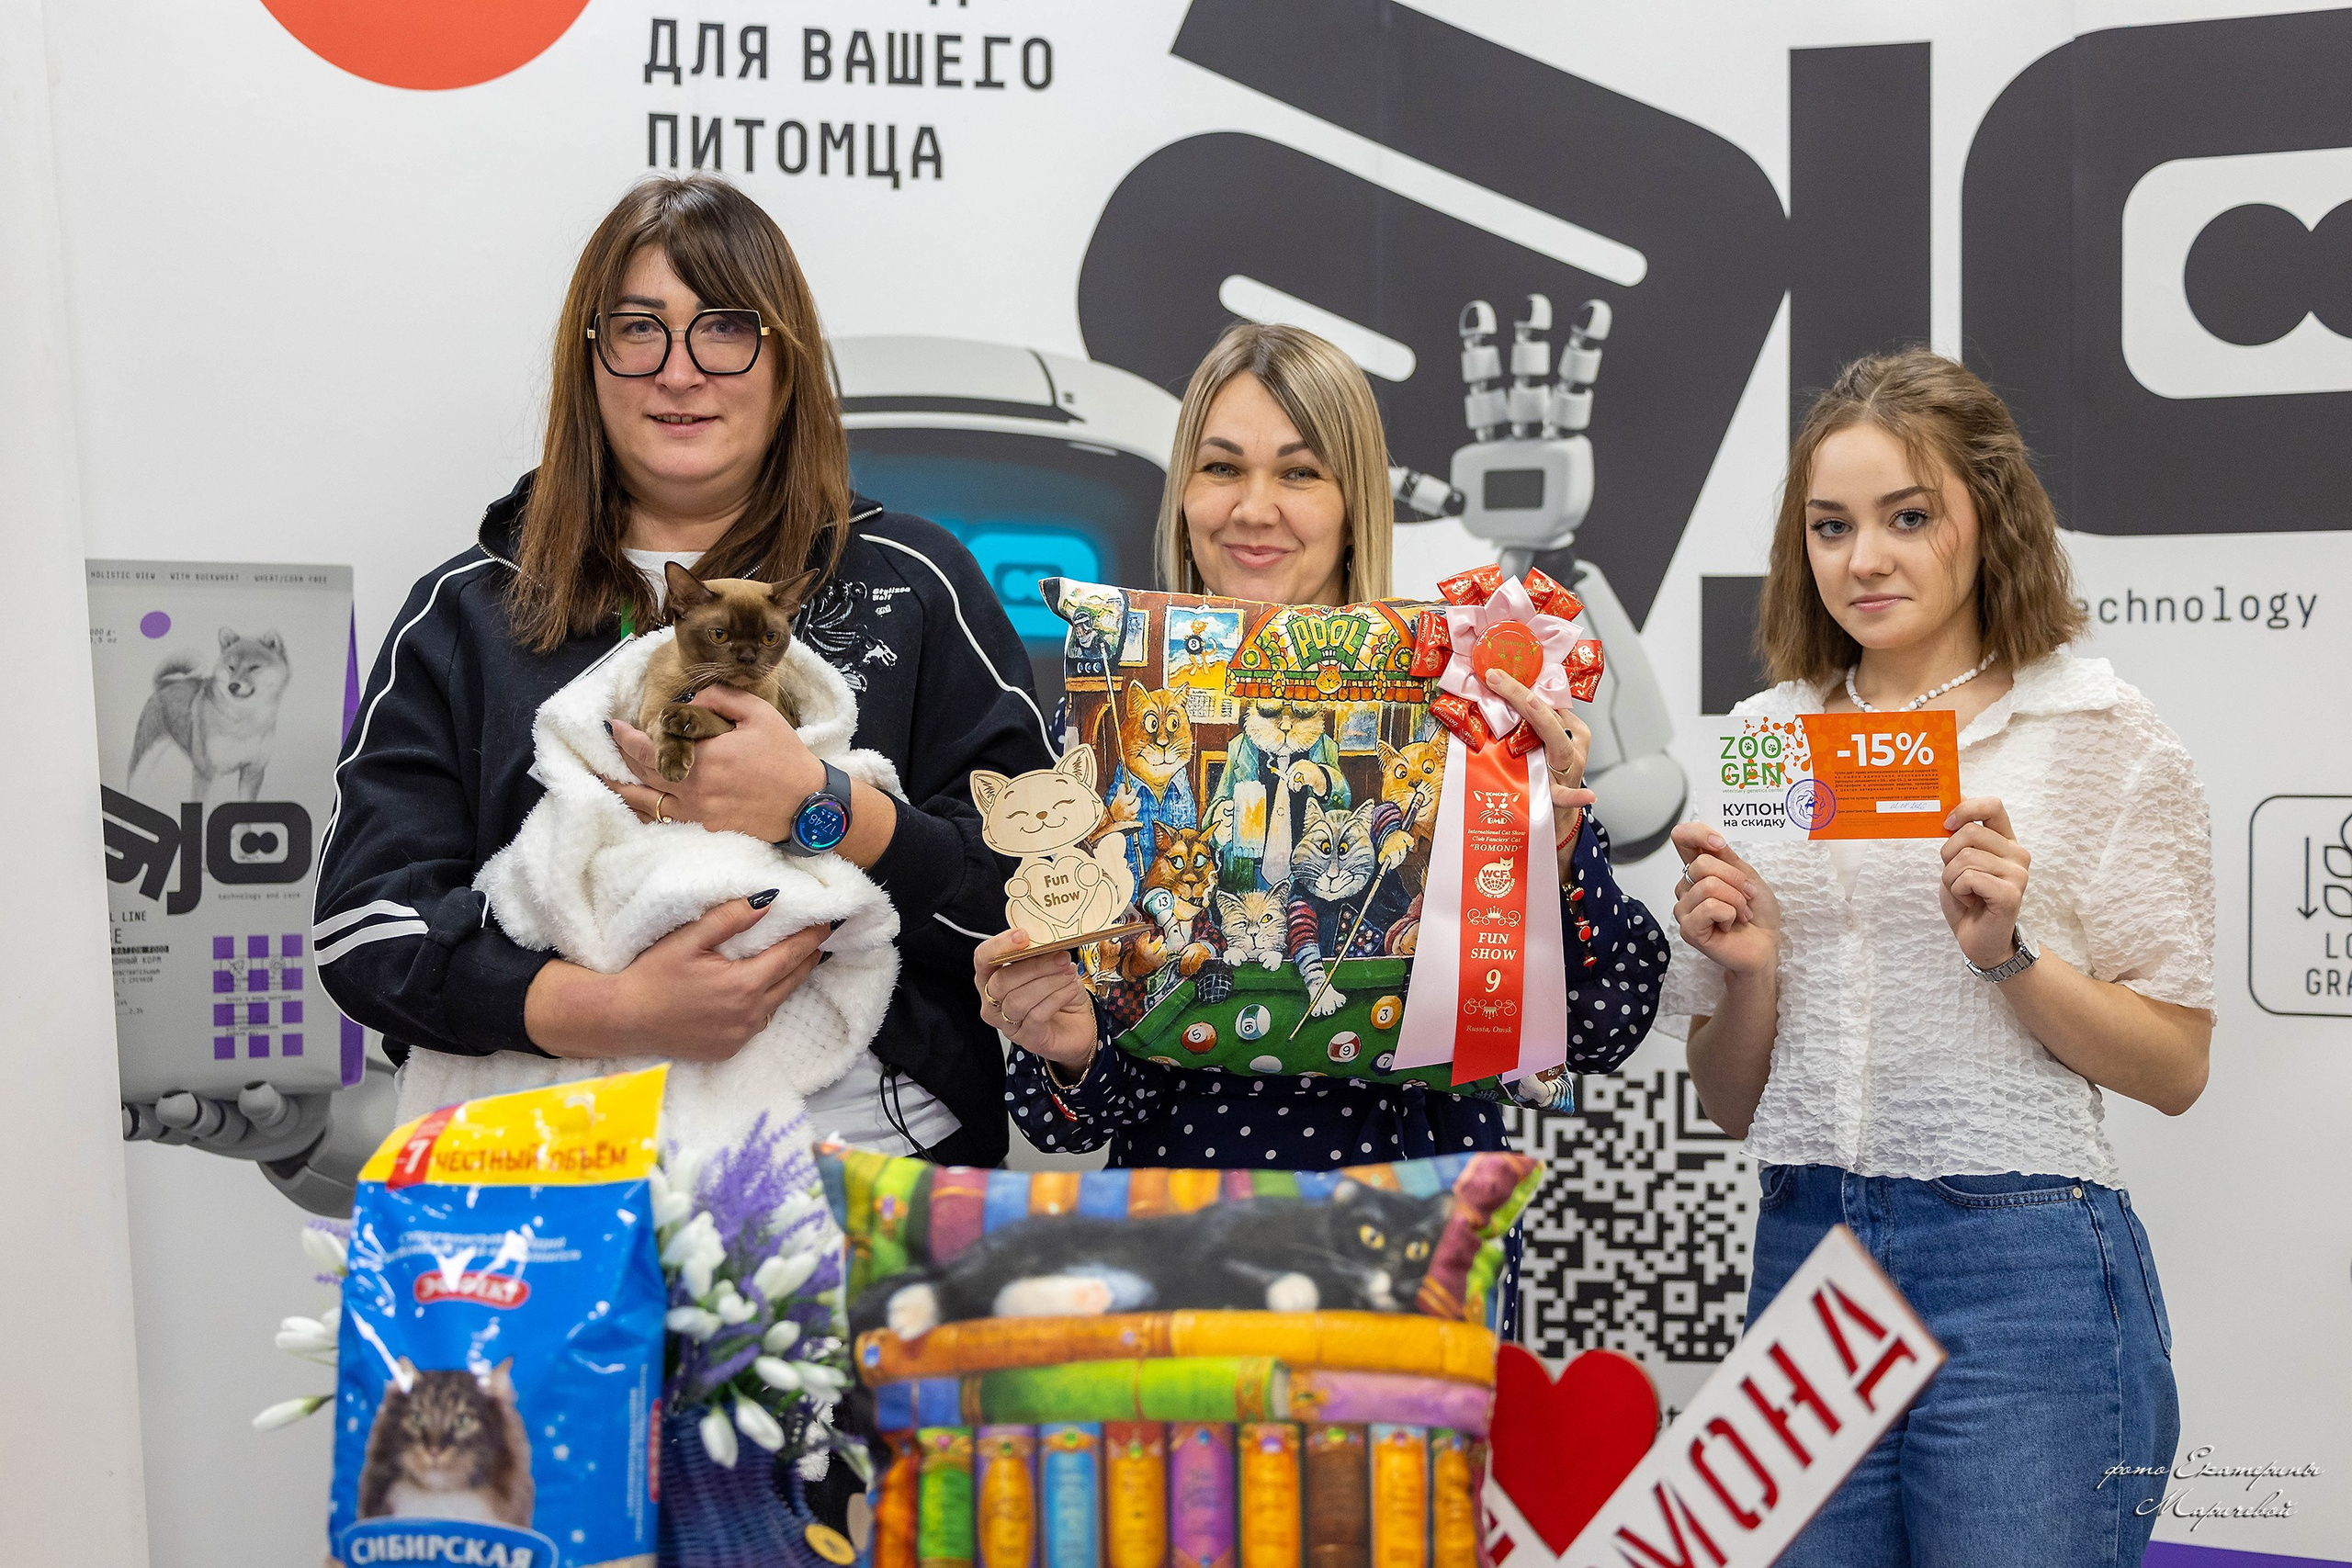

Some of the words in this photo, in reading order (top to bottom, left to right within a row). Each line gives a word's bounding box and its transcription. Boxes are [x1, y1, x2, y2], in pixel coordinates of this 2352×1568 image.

[643, 17, 768, 85] ДЛЯ
[802, 27, 1054, 91] ВАШЕГО
[647, 112, 943, 190] ПИТОМЦА
[91, 570, 130, 580] HOLISTIC
[135, 571, 155, 580] VIEW
[170, 572, 190, 581] WITH
[1191, 639, 1197, 649] 8
[1292, 617, 1360, 660] POOL
[1719, 735, 1782, 760] ZOO
[1837, 732, 1935, 767] -15%
[1721, 761, 1781, 786] GEN
[1723, 802, 1785, 817] КУПОН
[1741, 818, 1786, 829] скидку
[1044, 872, 1069, 888] Fun
[1482, 869, 1508, 878] WCF
[1043, 889, 1080, 908] Show
[1158, 896, 1169, 908] 13
[122, 910, 146, 922] LINE
[1477, 931, 1510, 944] FUN
[1470, 947, 1517, 961] SHOW
[1485, 968, 1501, 993] 9
[1379, 1009, 1388, 1021] 3
[1192, 1028, 1202, 1041] 5
[1466, 1024, 1490, 1032] Russia,
[1492, 1025, 1512, 1033] Omsk
[1342, 1045, 1351, 1055] 9
[1383, 1056, 1390, 1066] 7
[435, 1143, 538, 1173] ЧЕСТНЫЙ
[350, 1532, 534, 1568] СИБИРСКАЯ
